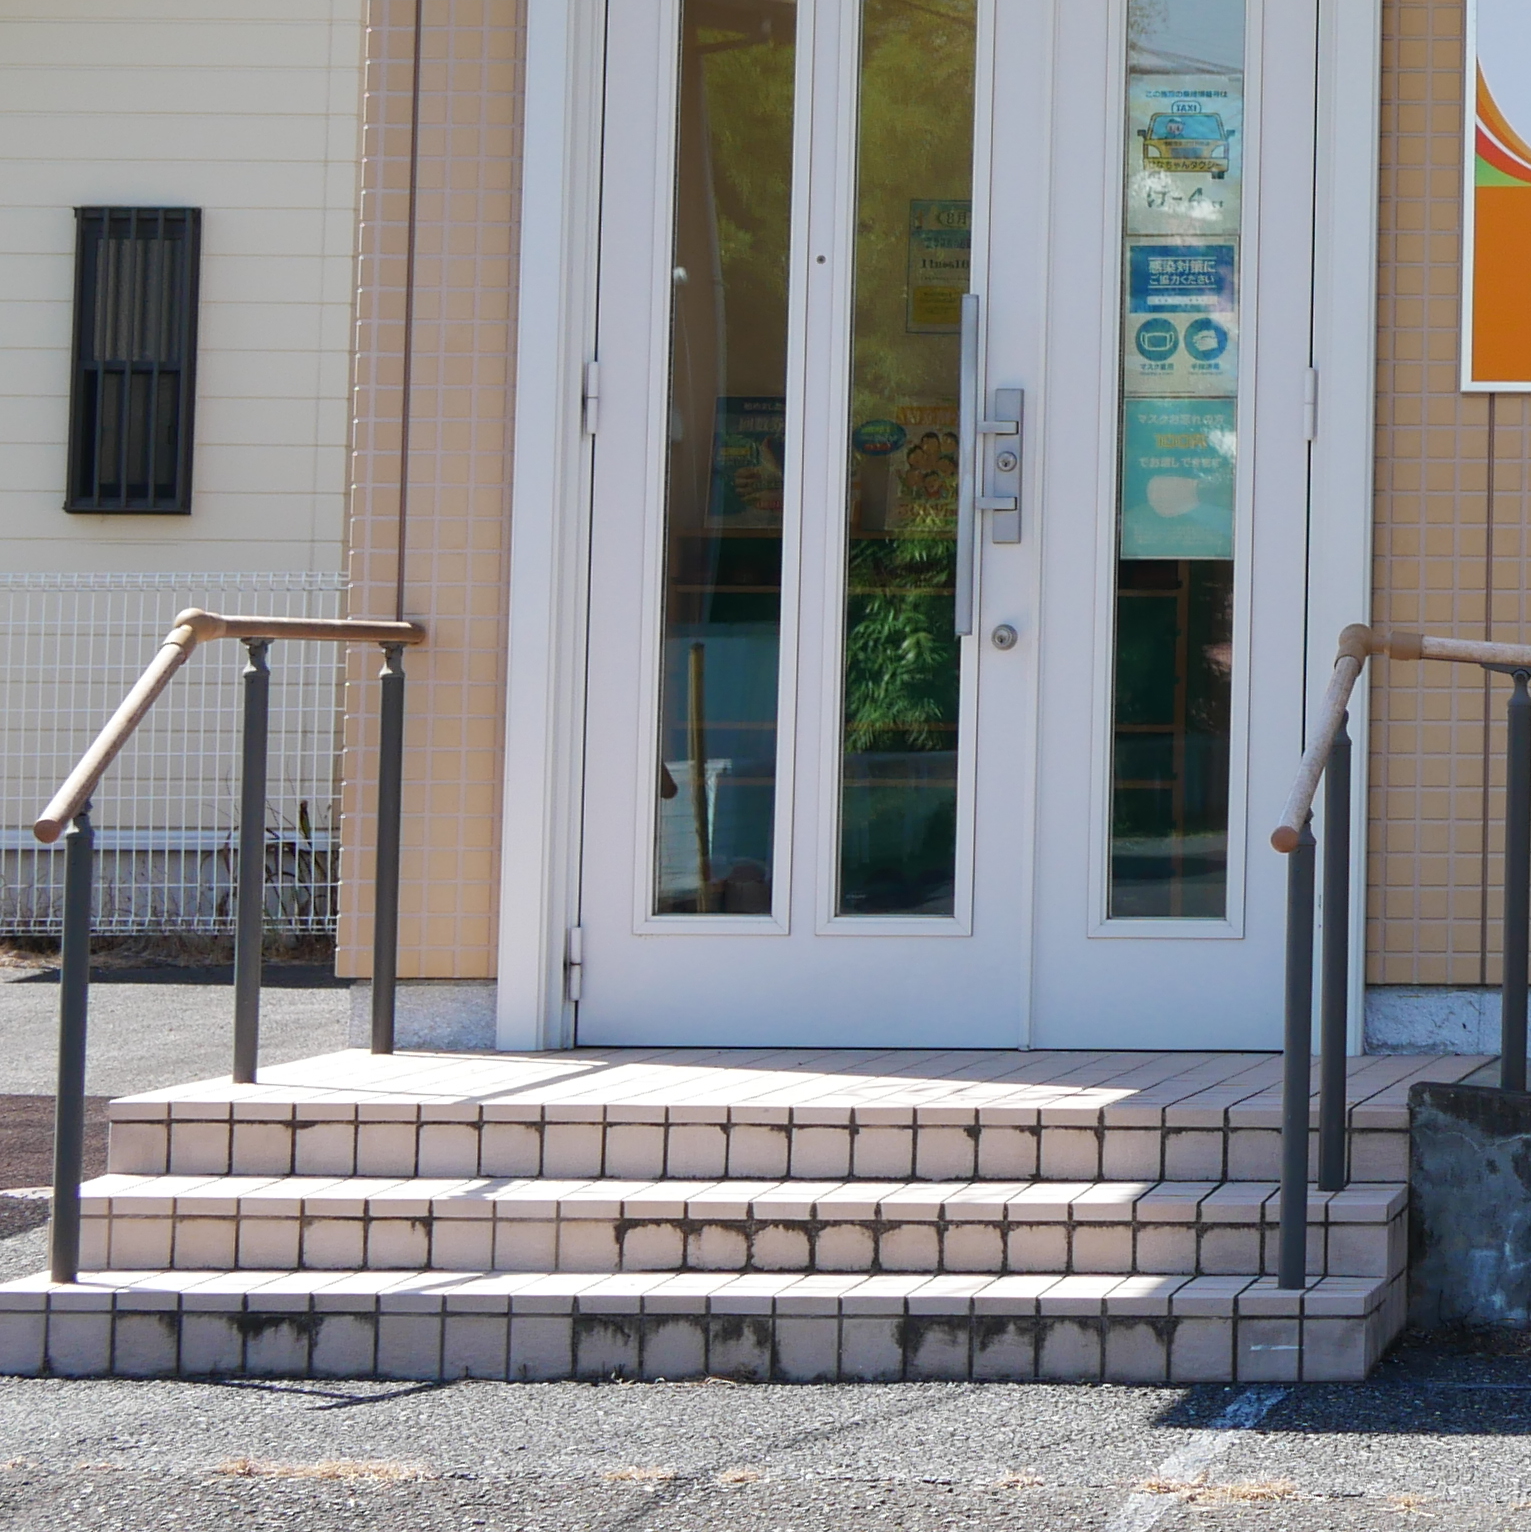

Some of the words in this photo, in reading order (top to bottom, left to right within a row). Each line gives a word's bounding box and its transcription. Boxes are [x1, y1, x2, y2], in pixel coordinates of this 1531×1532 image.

[1176, 104, 1198, 113] TAXI
[1148, 260, 1216, 274] 感染対策に
[1149, 275, 1215, 286] ご協力ください
